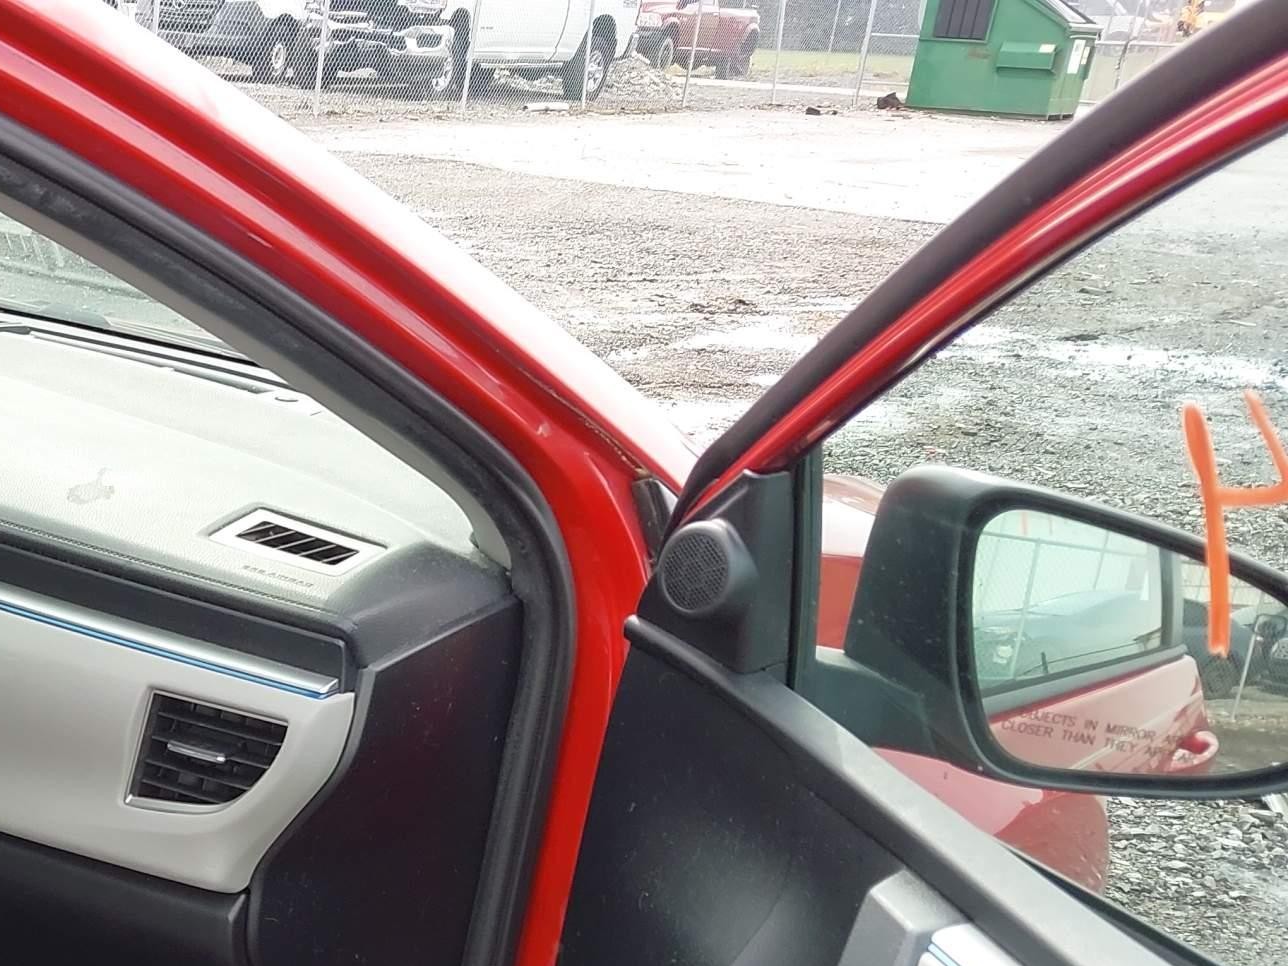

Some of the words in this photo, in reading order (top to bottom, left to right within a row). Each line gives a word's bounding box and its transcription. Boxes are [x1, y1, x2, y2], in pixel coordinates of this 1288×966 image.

[1001, 720, 1054, 738] CLOSER
[1062, 729, 1097, 746] THAN
[1104, 737, 1137, 753] THEY
[1144, 746, 1195, 763] APAR
[1084, 719, 1099, 731] IN
[1105, 723, 1157, 742] MIRROR
